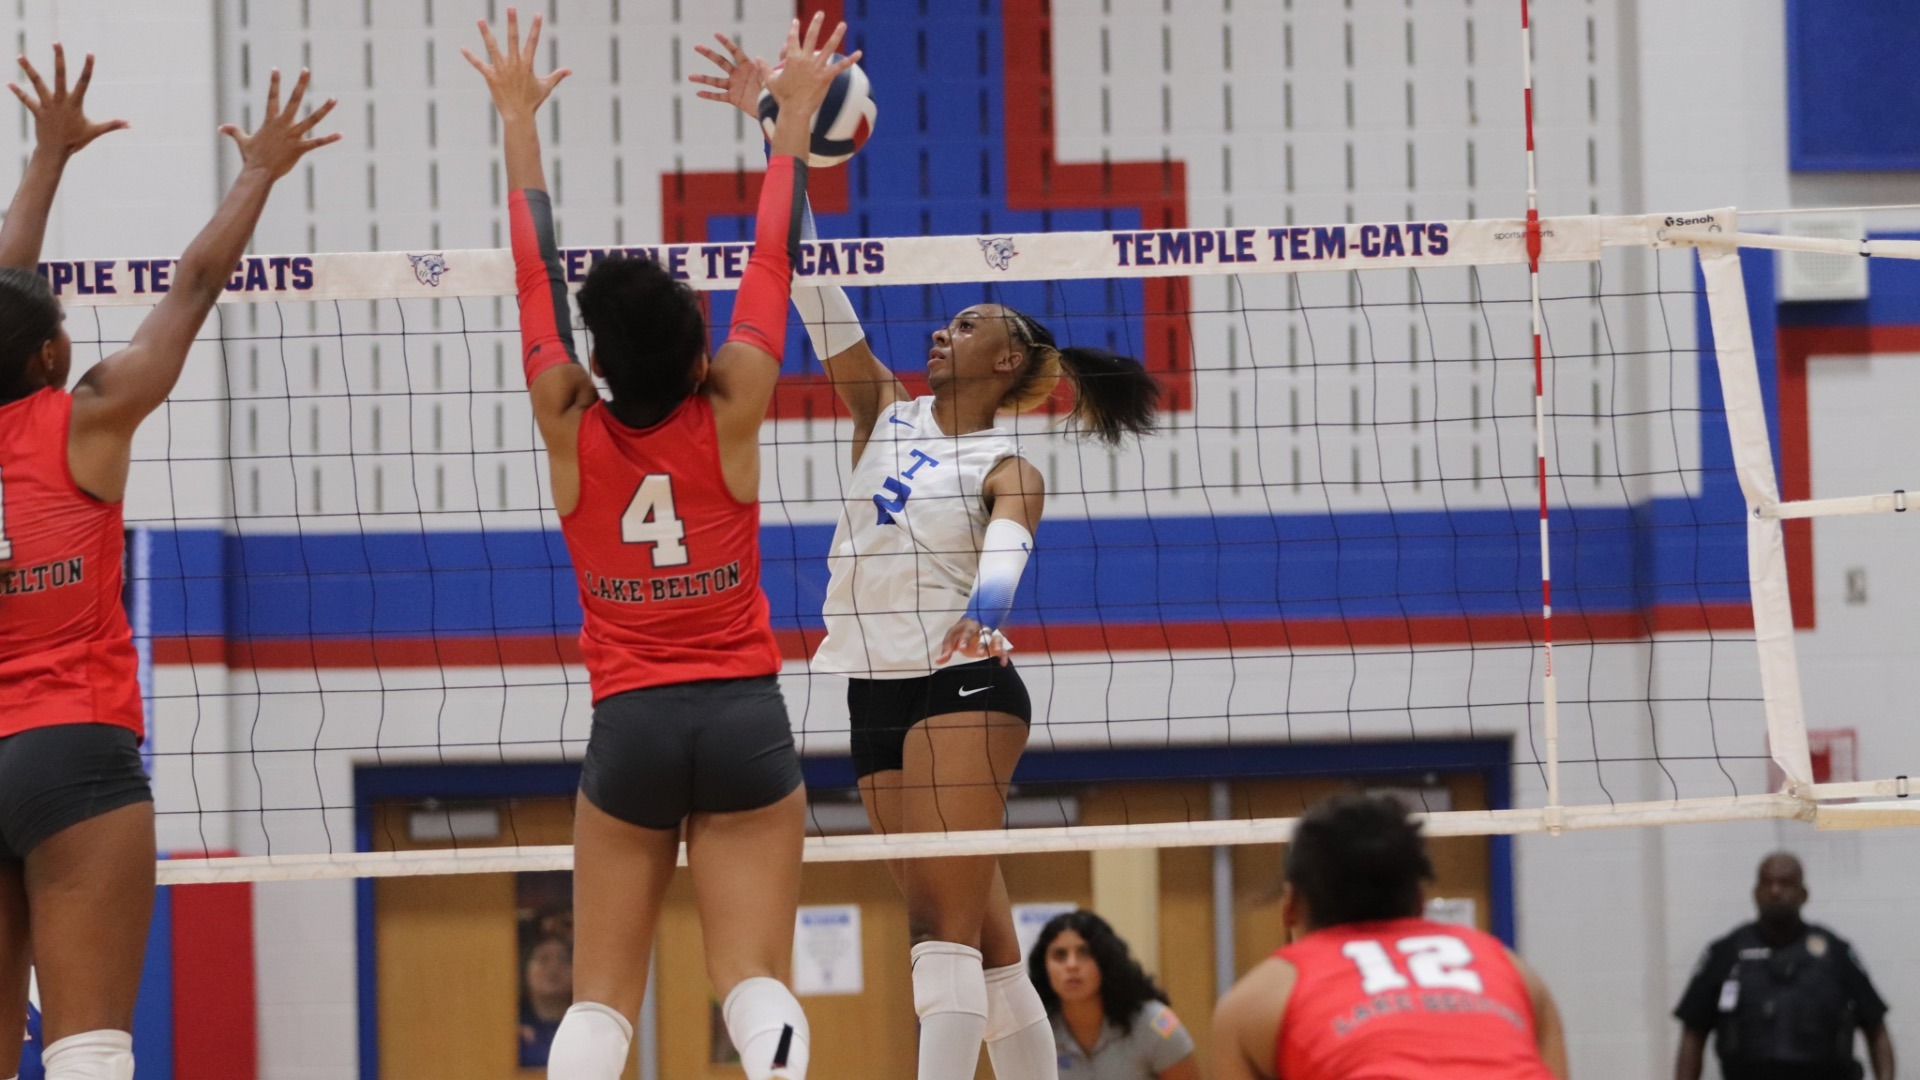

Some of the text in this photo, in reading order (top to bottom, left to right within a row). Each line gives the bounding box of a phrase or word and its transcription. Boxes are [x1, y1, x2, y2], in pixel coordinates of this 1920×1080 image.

[1494, 231, 1521, 240] sports
[1675, 215, 1715, 227] Senoh
[701, 241, 885, 279] TECATS
[1112, 222, 1450, 267] TEMPLE TEM-CATS
[37, 261, 117, 295] PLE
[901, 448, 940, 480] T
[620, 472, 690, 569] 4
[0, 556, 83, 595] ELTON
[586, 561, 740, 602] LAKE BELTON
[1341, 934, 1485, 995] 12
